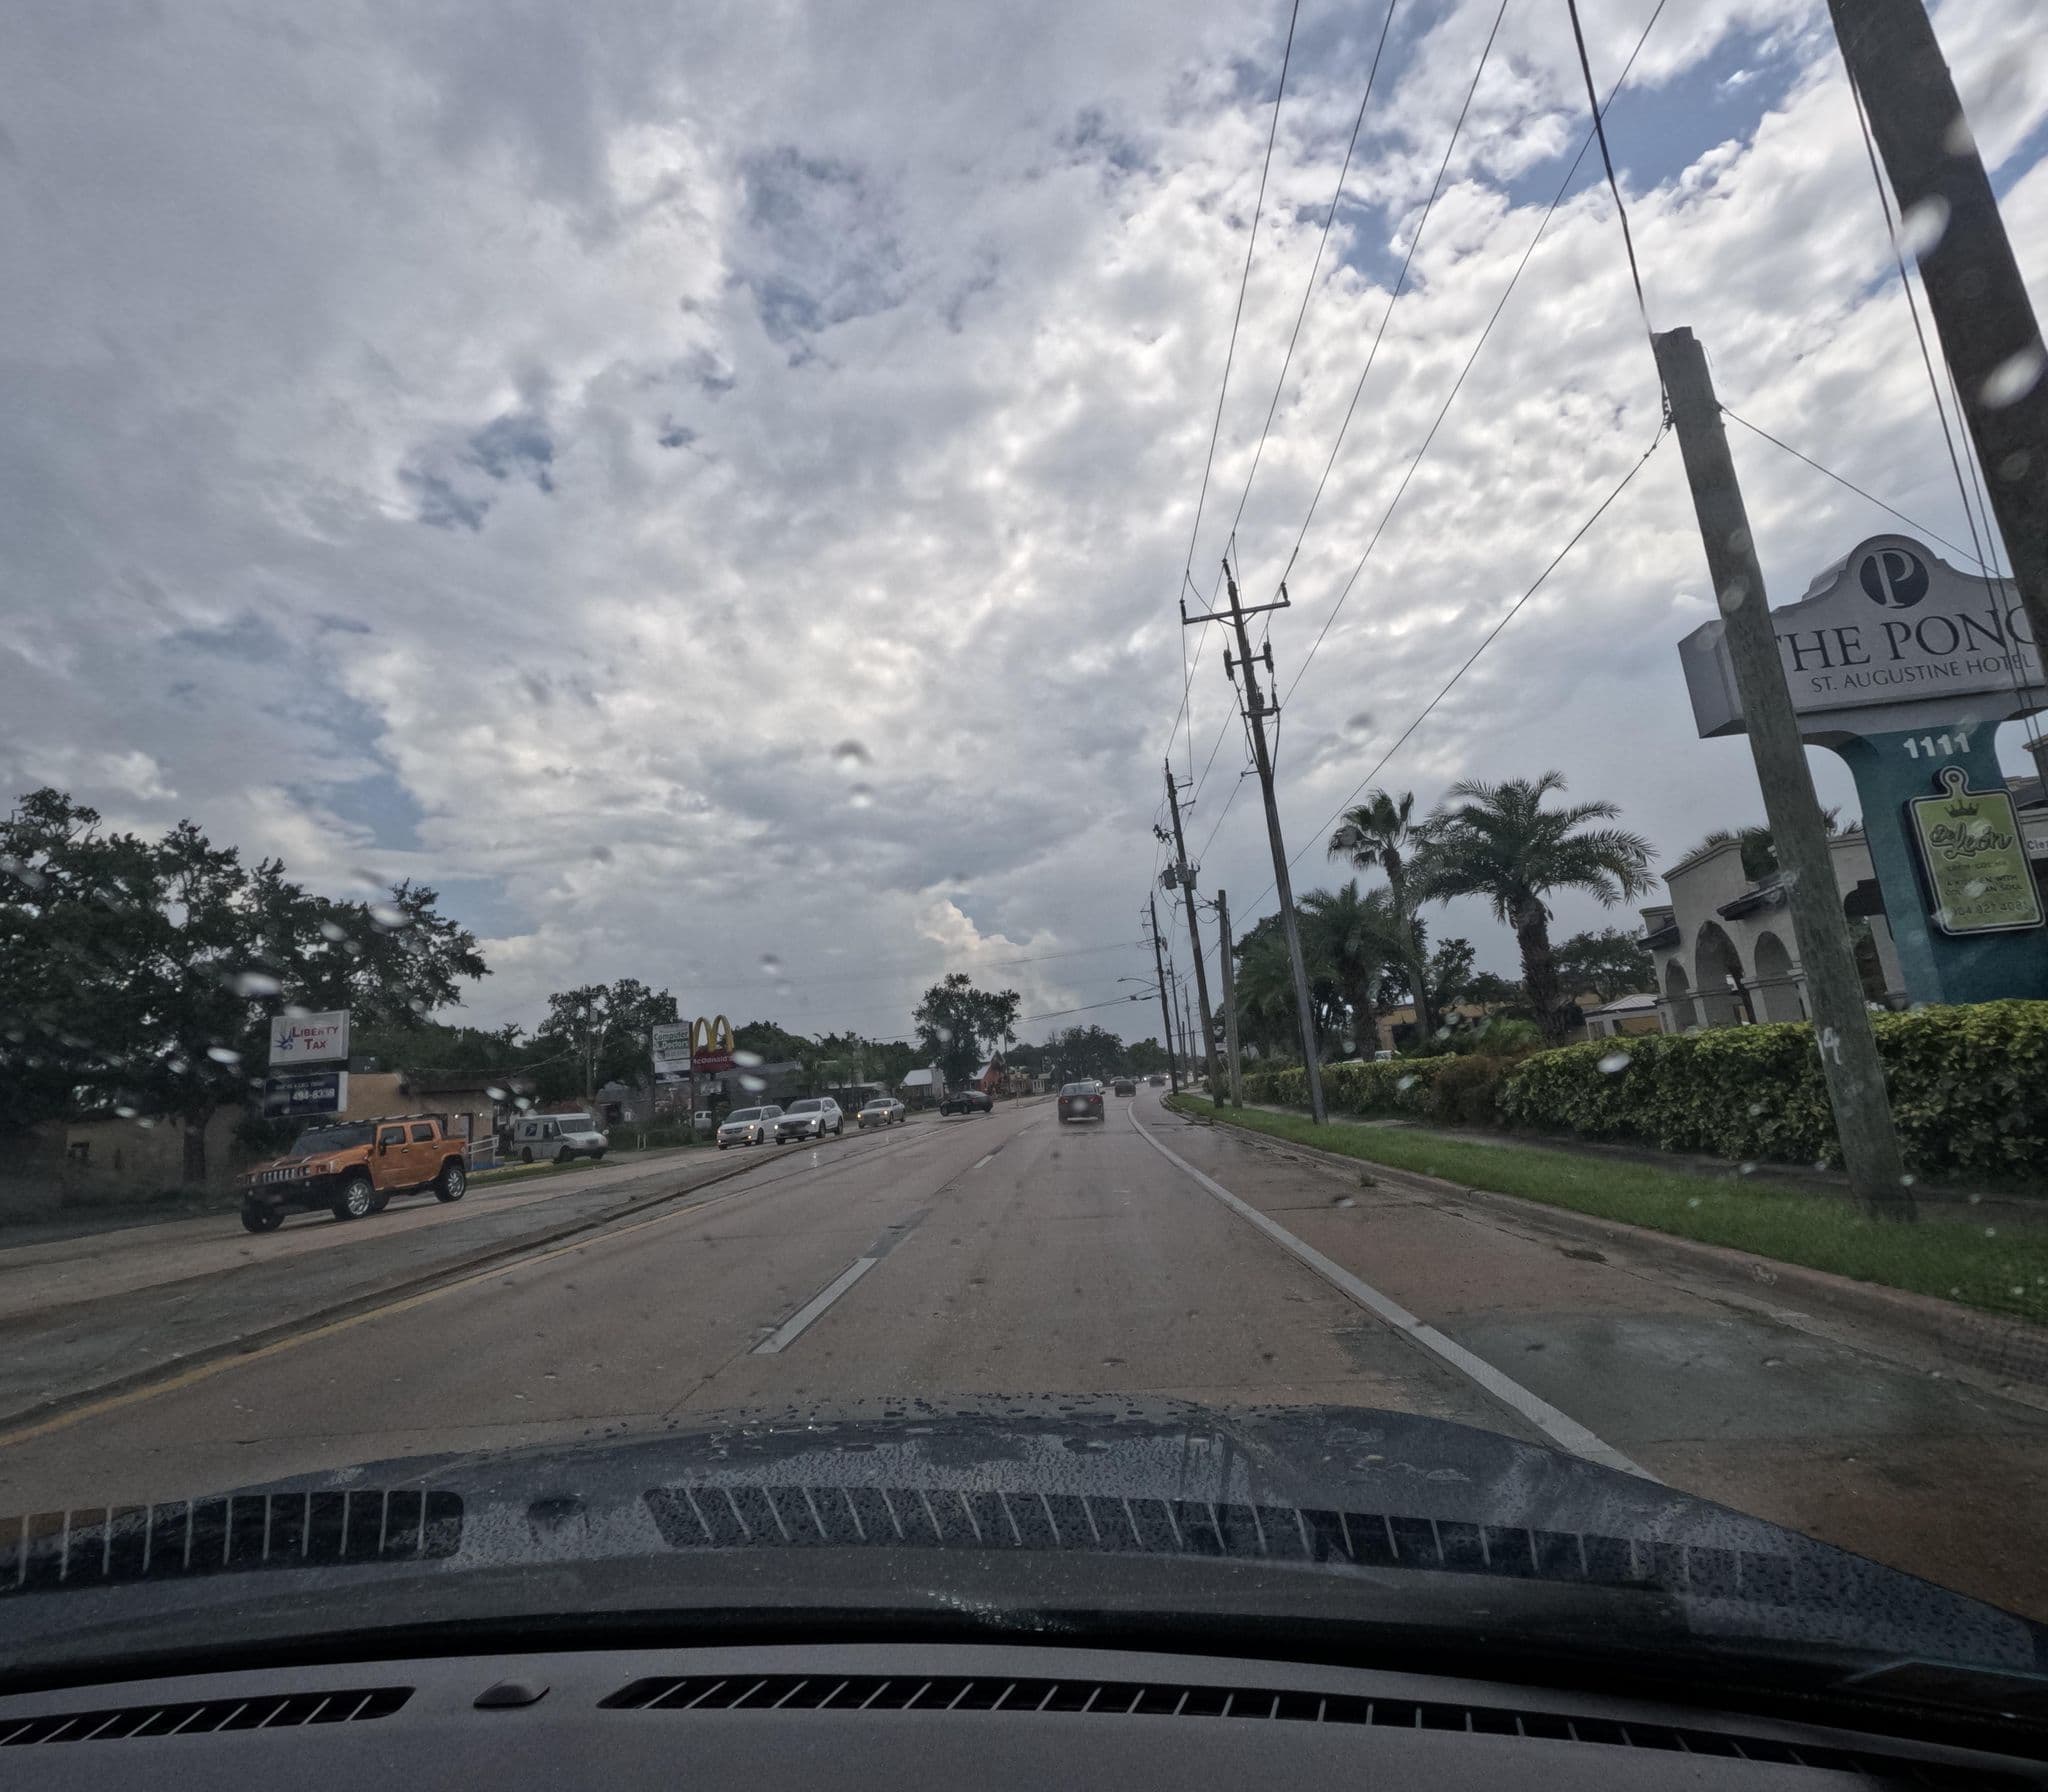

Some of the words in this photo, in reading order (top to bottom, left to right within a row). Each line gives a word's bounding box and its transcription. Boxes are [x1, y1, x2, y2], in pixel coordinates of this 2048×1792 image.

[1774, 625, 1871, 672] HE
[1811, 675, 1838, 693] ST.
[1844, 660, 1962, 690] AUGUSTINE
[1966, 652, 2035, 676] HOTEL
[1903, 732, 1971, 758] 1111
[292, 1025, 339, 1039] LIBERTY
[304, 1038, 328, 1050] TAX
